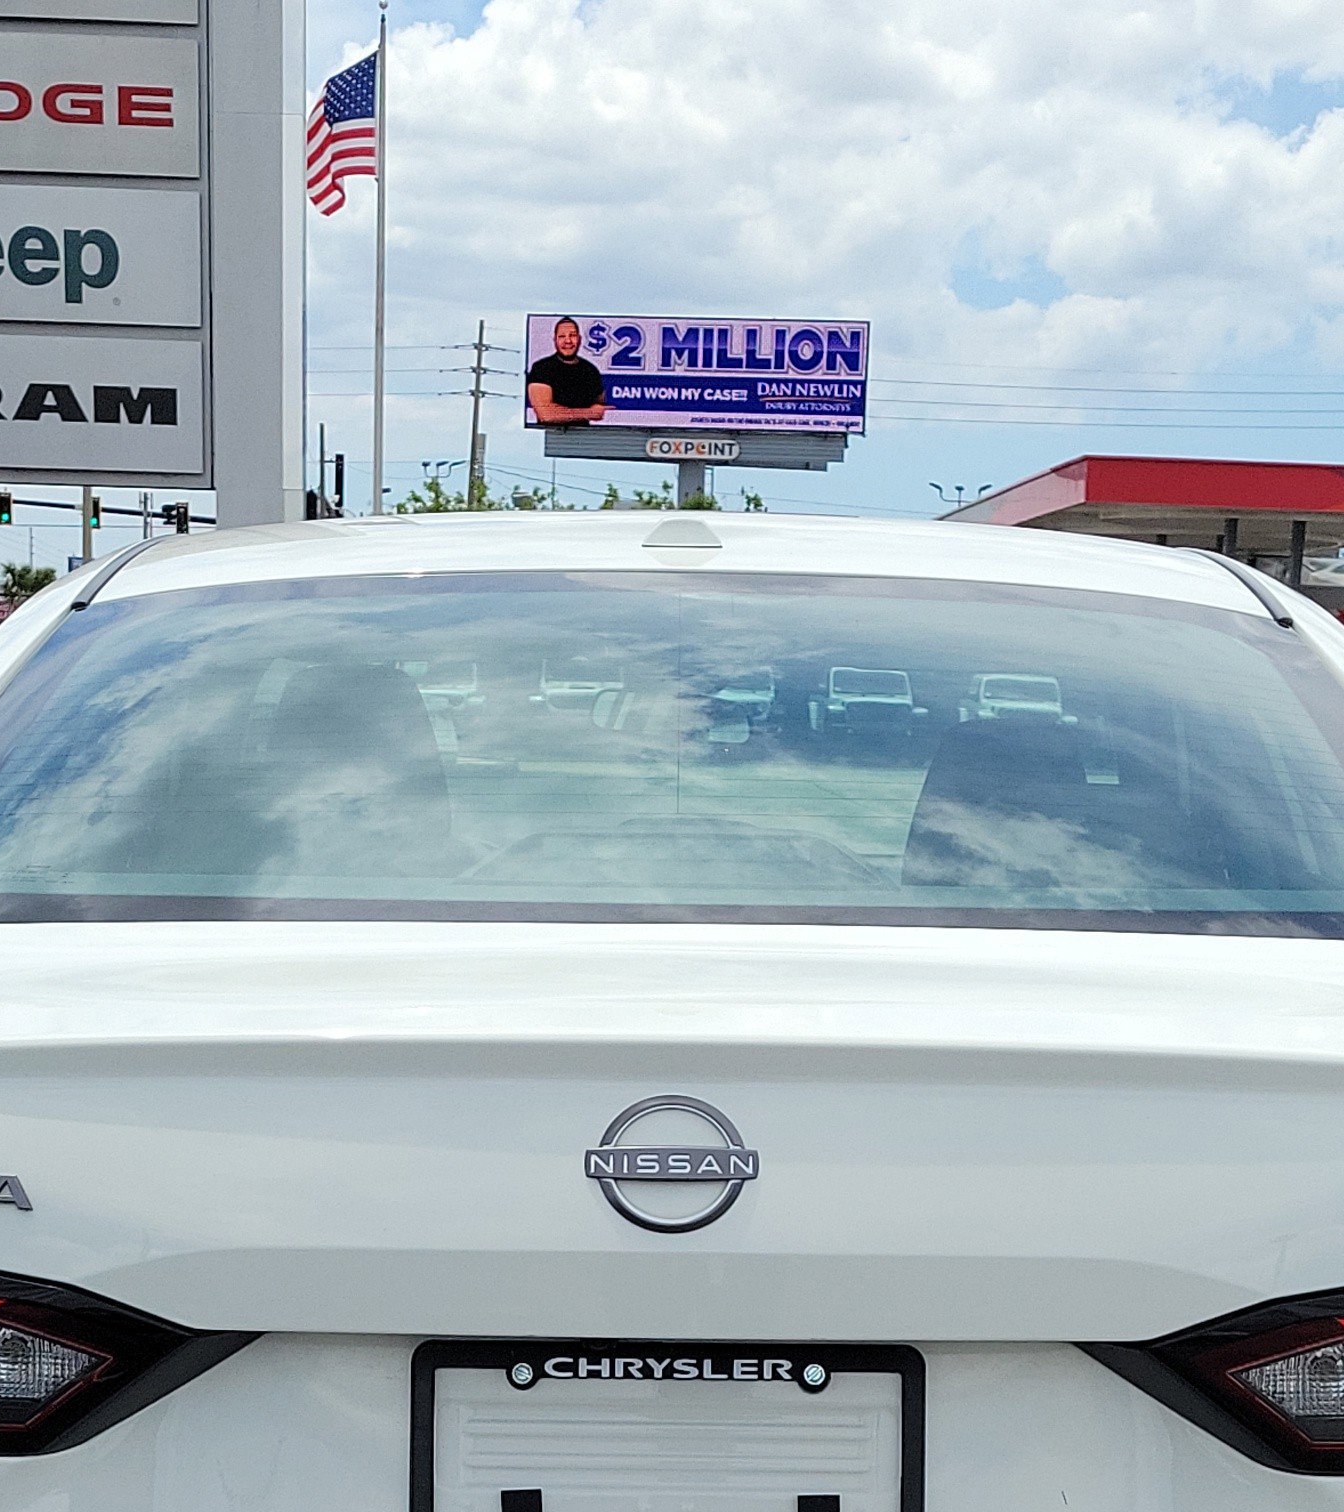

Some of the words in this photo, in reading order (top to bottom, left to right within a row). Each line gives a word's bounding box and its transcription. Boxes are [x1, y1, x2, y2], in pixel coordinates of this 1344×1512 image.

[586, 322, 645, 369] $2
[659, 326, 862, 373] MILLION
[612, 386, 641, 399] DAN
[643, 387, 678, 400] WON
[681, 387, 701, 401] MY
[757, 381, 793, 396] DAN
[795, 382, 862, 398] NEWLIN
[648, 440, 736, 457] FOXPOINT
[588, 1152, 757, 1178] NISSAN
[544, 1356, 794, 1382] CHRYSLER
